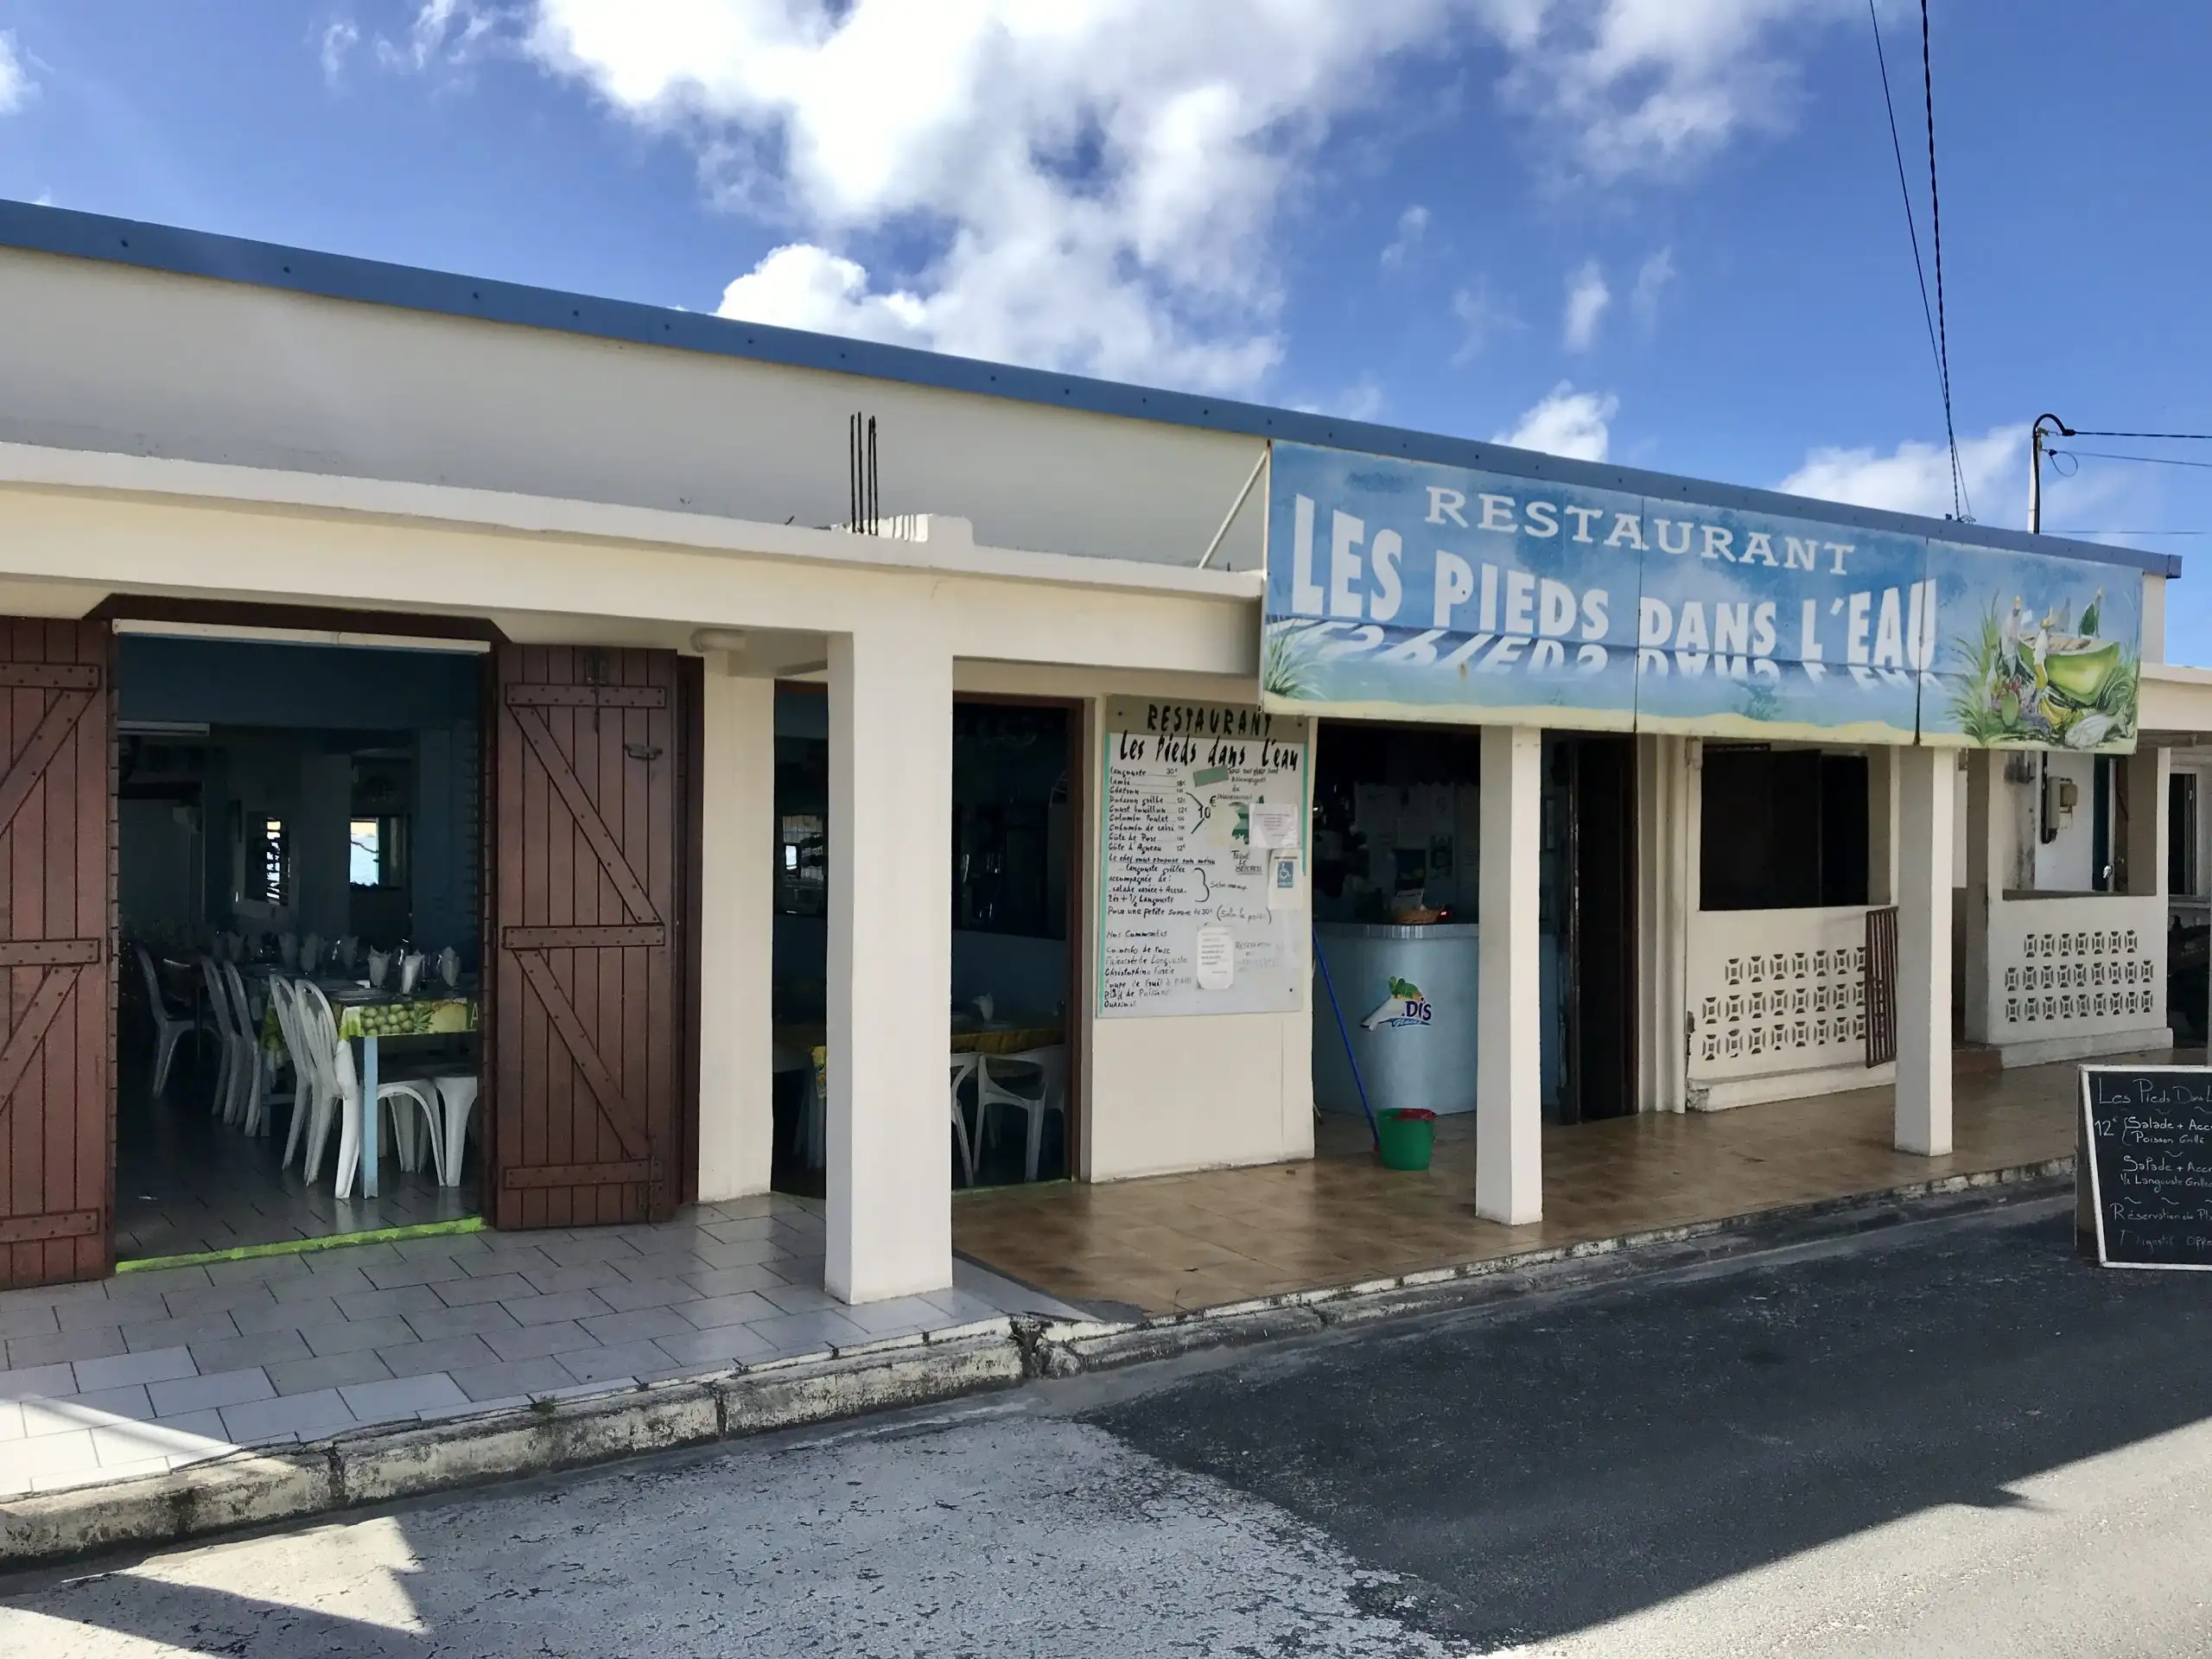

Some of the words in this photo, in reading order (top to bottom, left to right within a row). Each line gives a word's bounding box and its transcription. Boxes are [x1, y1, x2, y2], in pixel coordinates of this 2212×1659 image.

[1424, 486, 1855, 575] RESTAURANT
[1292, 493, 1403, 621] LES
[1433, 550, 1609, 641] PIEDS
[1639, 596, 1777, 657] DANS
[1801, 578, 1937, 671] L'EAU
[1147, 703, 1272, 736] RESTAURANT
[1119, 730, 1146, 761] Les
[1155, 733, 1197, 766] Pieds
[1209, 735, 1246, 767] dans
[1146, 823, 1154, 831] de
[2099, 1077, 2131, 1103] Les
[2132, 1077, 2171, 1103] Pieds
[2126, 1116, 2174, 1129] Salade
[2131, 1130, 2174, 1144] Poisson
[2135, 1174, 2183, 1193] Langouste
[2108, 1203, 2180, 1220] Réservation
